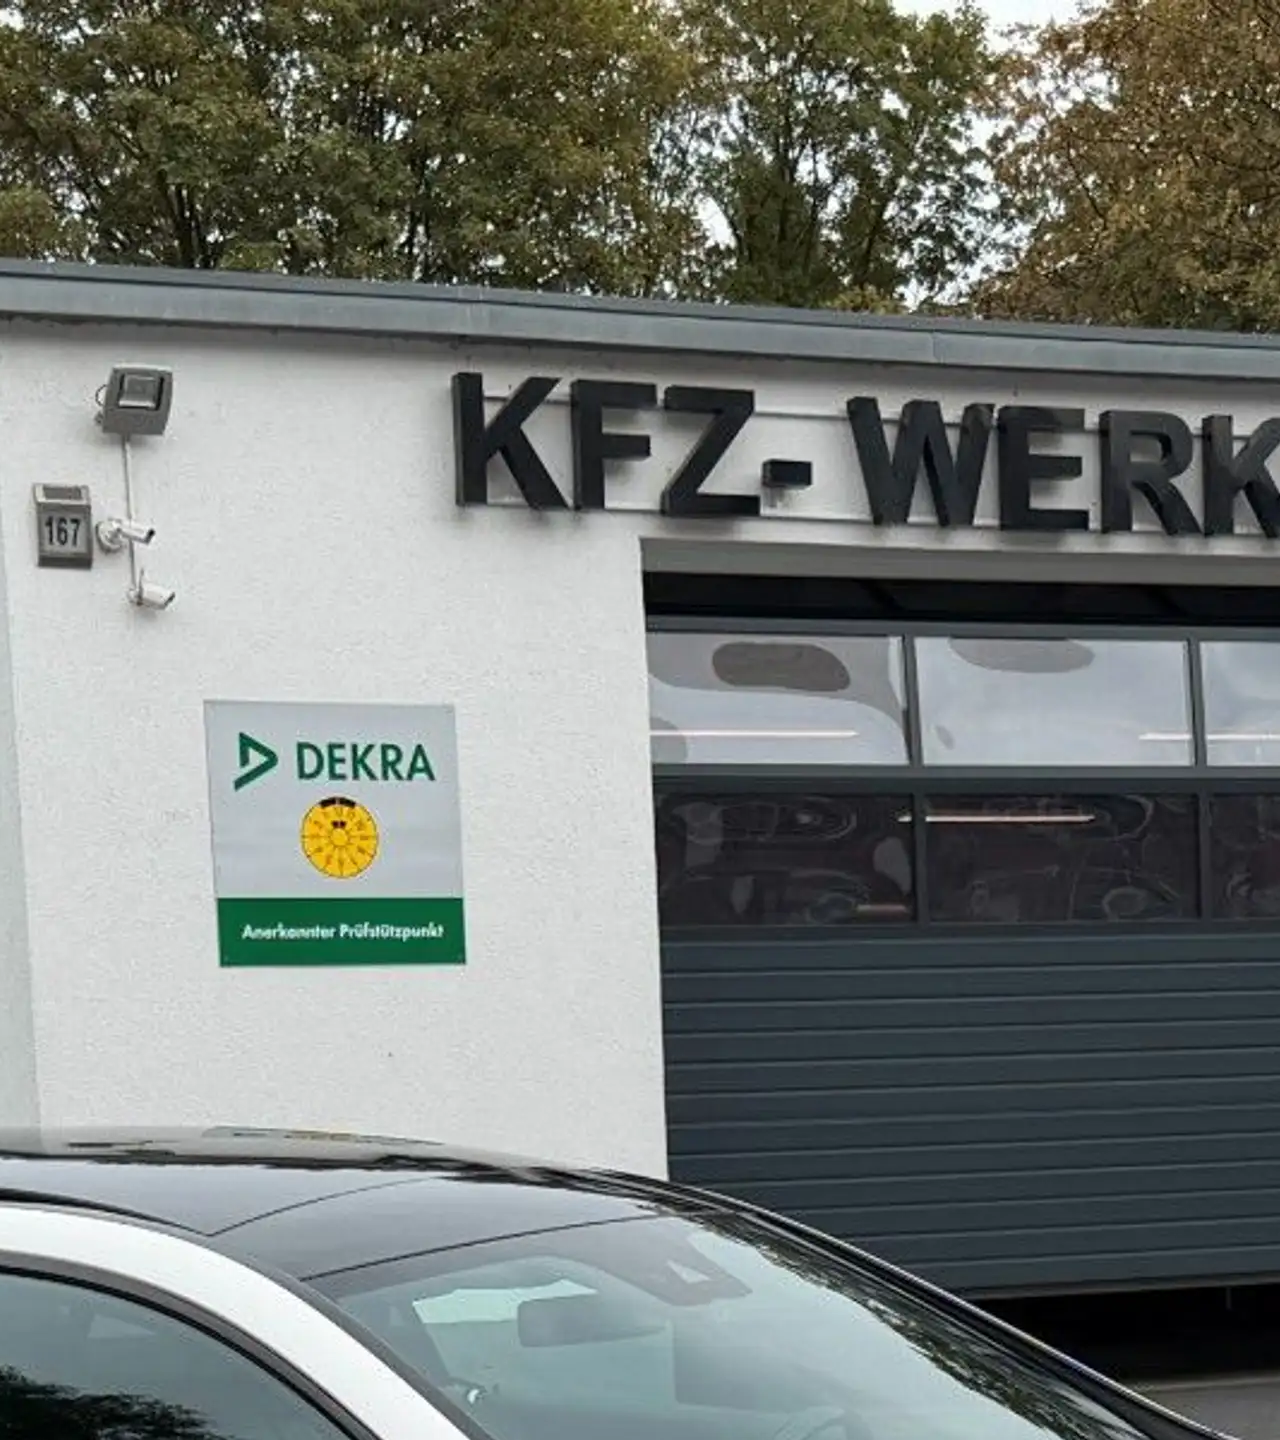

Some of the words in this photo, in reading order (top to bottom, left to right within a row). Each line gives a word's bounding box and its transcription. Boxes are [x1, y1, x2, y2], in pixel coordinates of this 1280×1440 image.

[44, 516, 81, 547] 167
[296, 742, 436, 781] DEKRA
[241, 923, 336, 941] Anerkannter
[339, 922, 444, 943] Prüfstützpunkt
